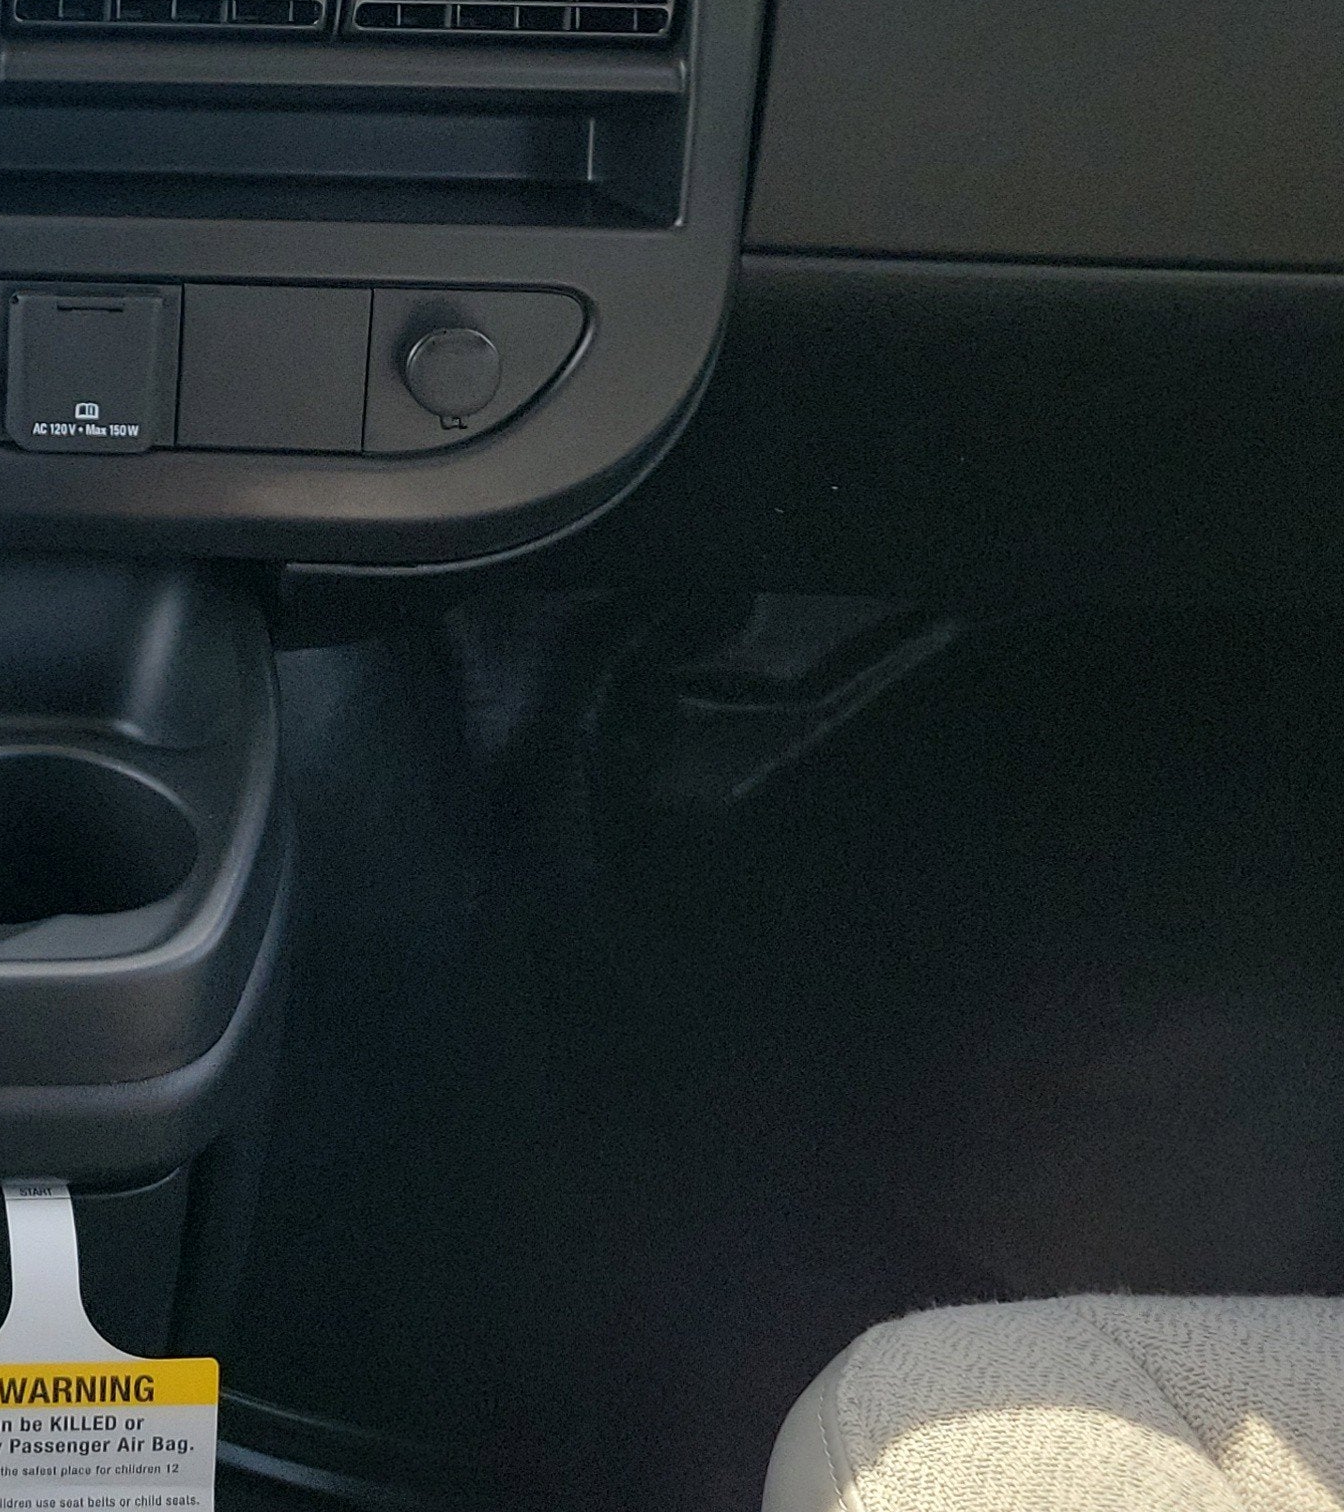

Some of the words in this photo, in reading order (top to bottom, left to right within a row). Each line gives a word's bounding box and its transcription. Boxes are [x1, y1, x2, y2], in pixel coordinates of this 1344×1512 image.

[33, 423, 47, 435] AC
[85, 424, 107, 435] Max
[19, 1188, 52, 1197] START
[21, 1417, 42, 1432] be
[50, 1416, 117, 1432] KILLED
[124, 1418, 145, 1432] or
[9, 1437, 110, 1457] Passenger
[117, 1437, 145, 1453] Air
[152, 1436, 195, 1455] Bag.
[1, 1466, 17, 1477] the
[22, 1465, 57, 1476] safest
[61, 1465, 91, 1477] place
[96, 1465, 111, 1475] for
[115, 1464, 161, 1475] children
[166, 1463, 179, 1474] 12
[36, 1499, 56, 1508] use
[60, 1497, 84, 1508] seat
[88, 1496, 116, 1507] belts
[120, 1498, 131, 1507] or
[135, 1495, 162, 1506] child
